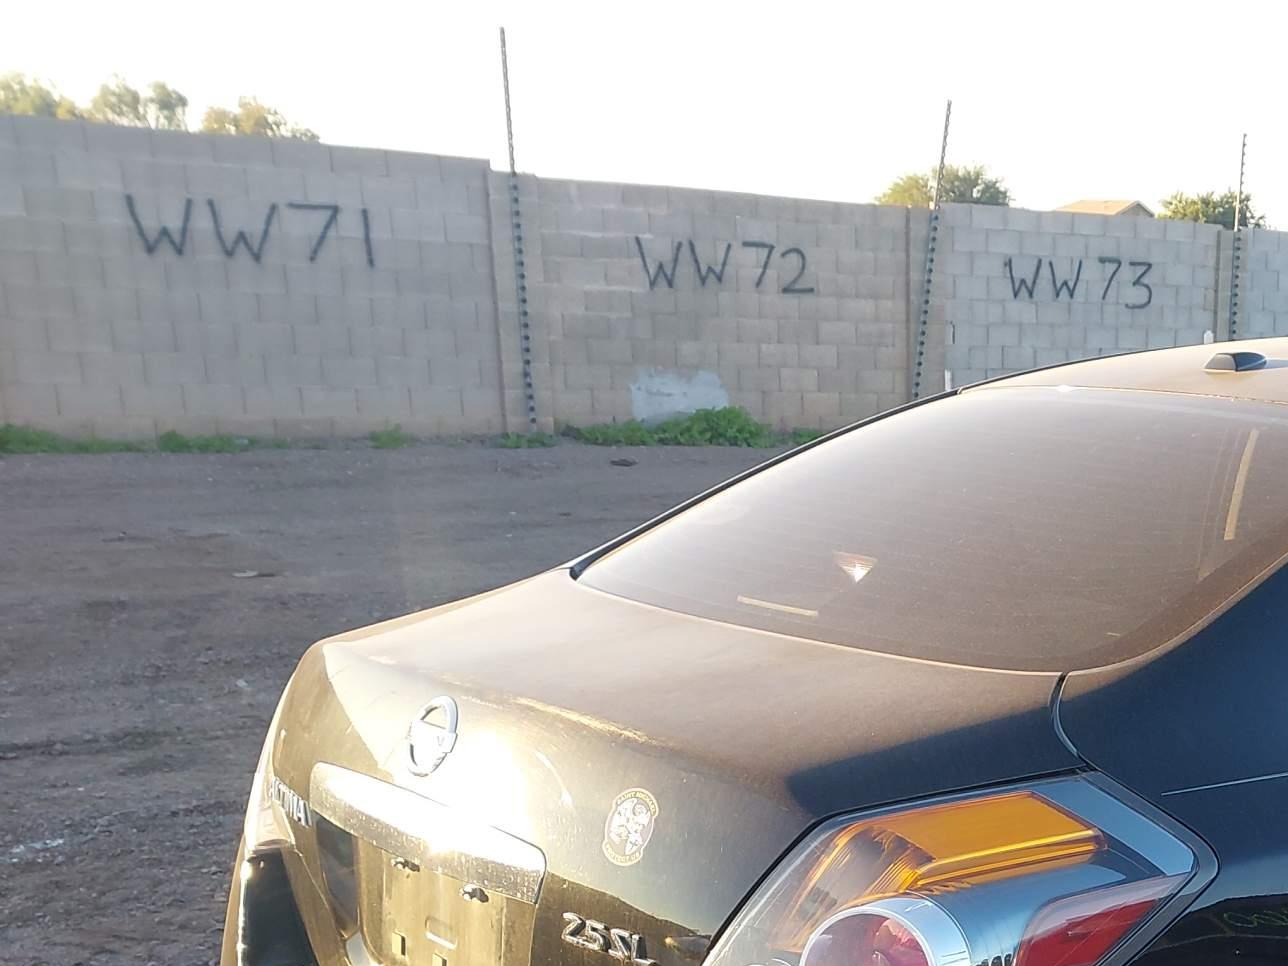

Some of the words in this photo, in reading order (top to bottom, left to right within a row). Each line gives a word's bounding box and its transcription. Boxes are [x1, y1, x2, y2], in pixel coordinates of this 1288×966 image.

[125, 194, 376, 268] WW71
[635, 236, 815, 294] WW72
[1005, 257, 1153, 310] WW73
